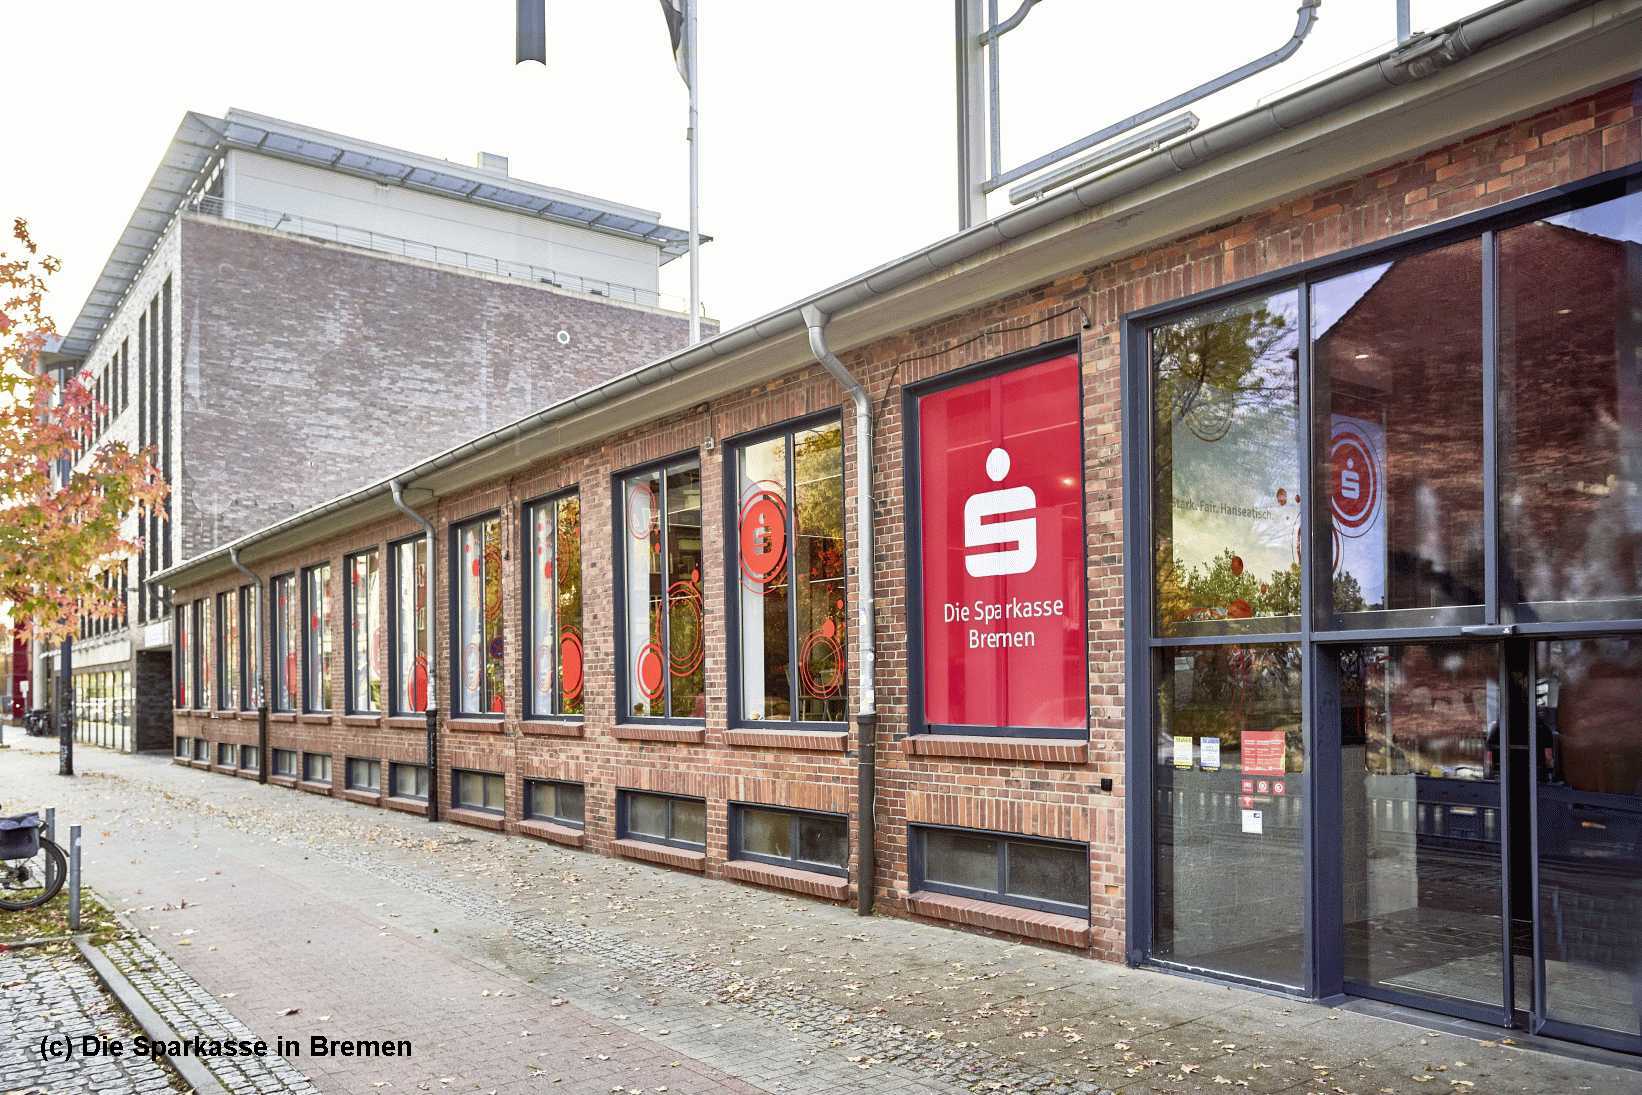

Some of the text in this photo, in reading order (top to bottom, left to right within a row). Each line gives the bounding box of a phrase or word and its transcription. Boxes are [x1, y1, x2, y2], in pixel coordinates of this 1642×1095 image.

[944, 597, 1063, 625] Die Sparkasse
[969, 629, 1035, 649] Bremen
